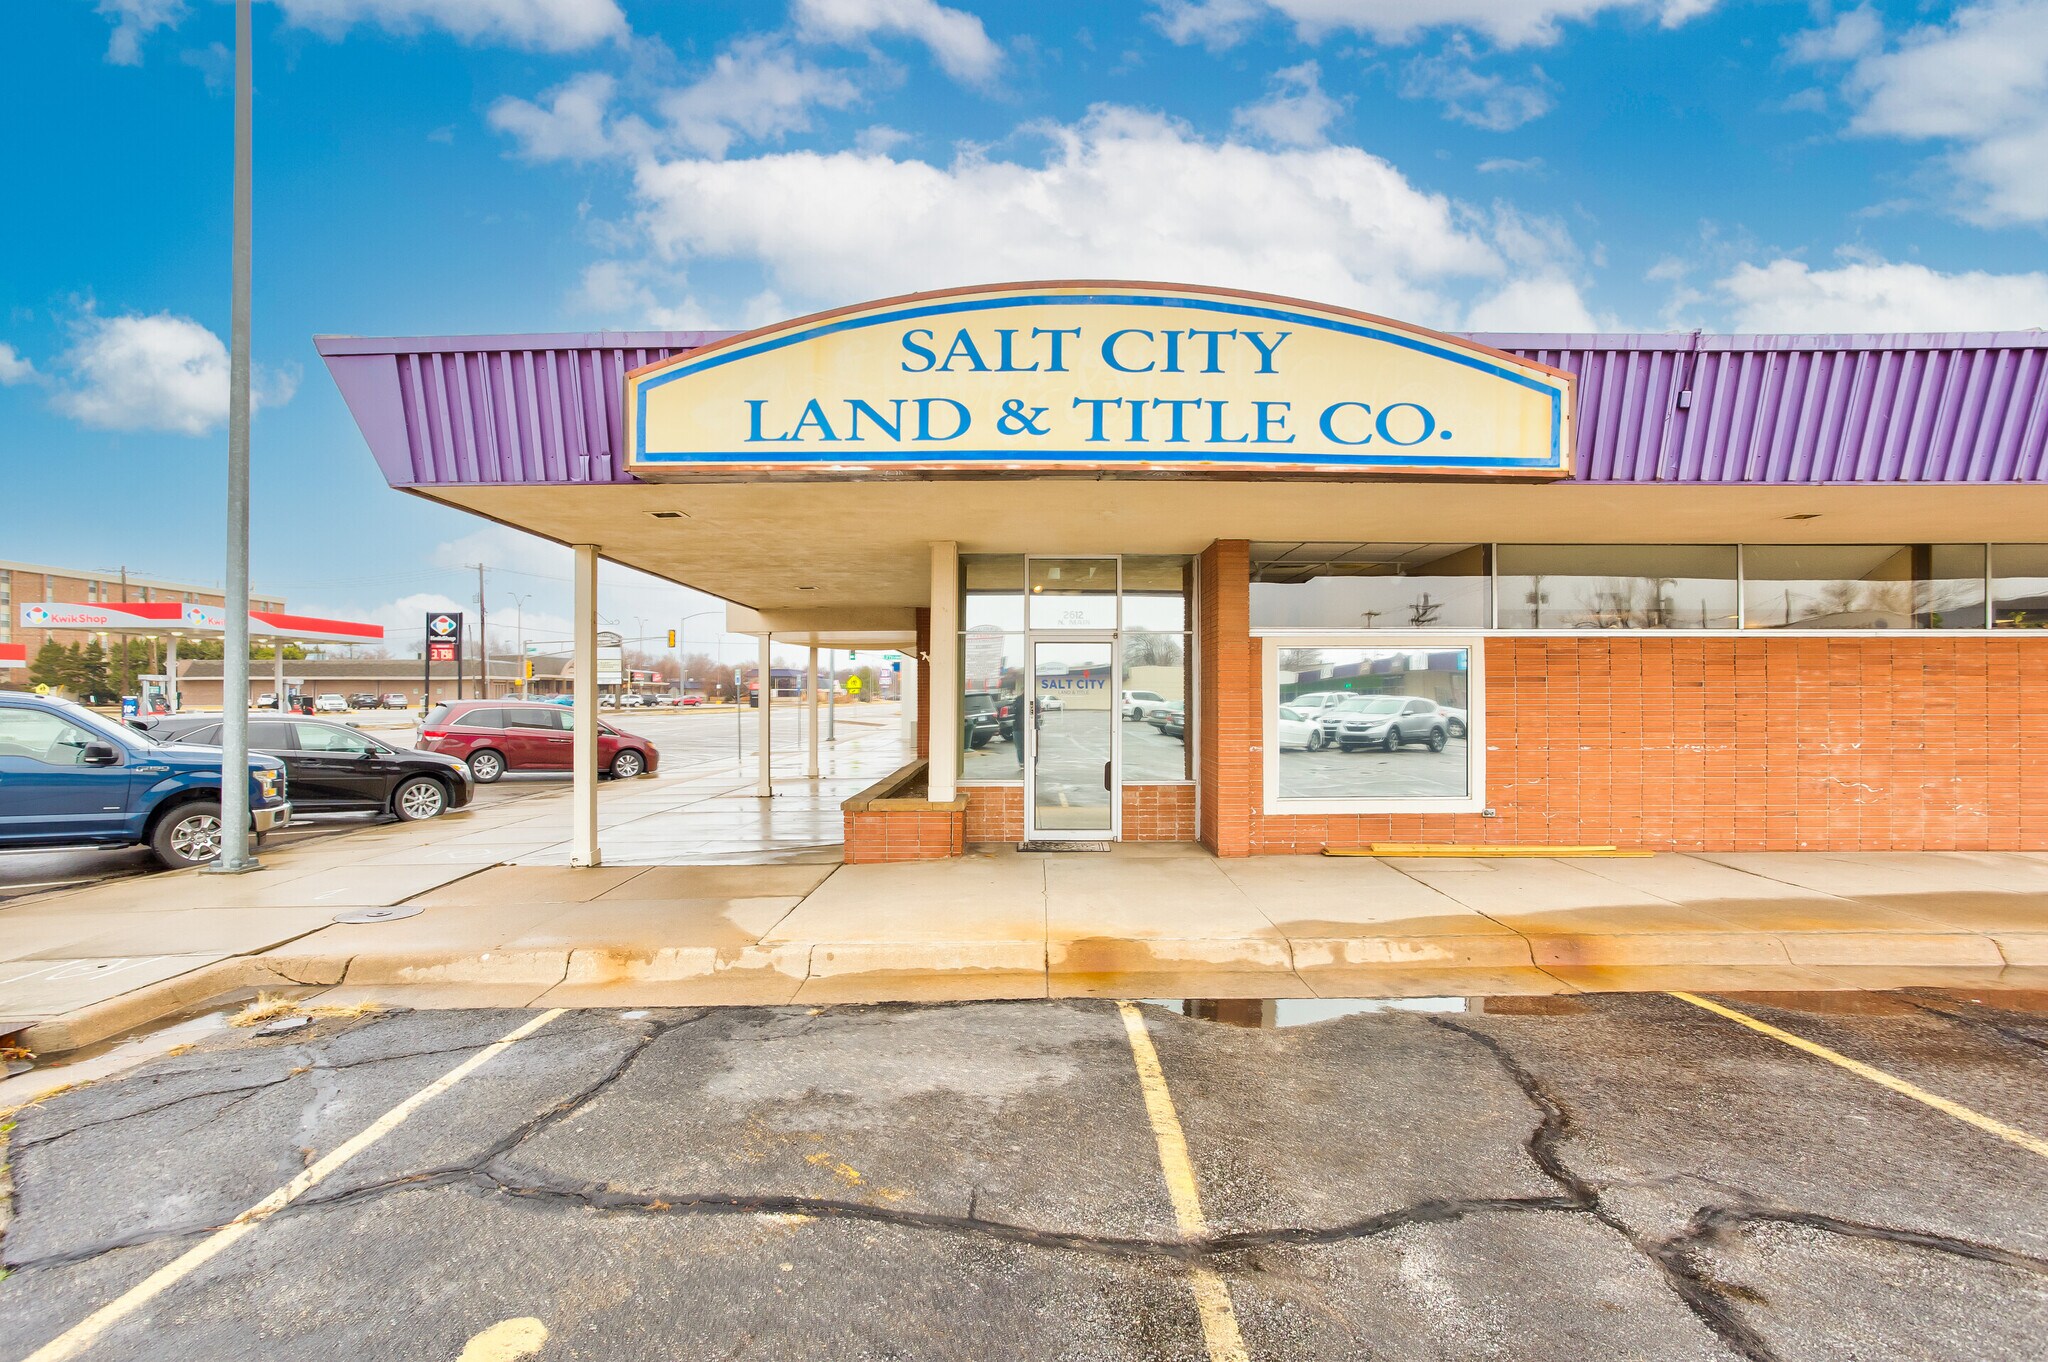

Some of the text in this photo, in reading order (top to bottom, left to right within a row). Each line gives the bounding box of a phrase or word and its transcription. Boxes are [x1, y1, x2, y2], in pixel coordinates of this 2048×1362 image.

[901, 328, 1291, 375] SALT CITY
[745, 396, 1453, 447] LAND & TITLE CO.
[1063, 610, 1085, 620] 2612
[1041, 679, 1105, 689] SALT CITY
